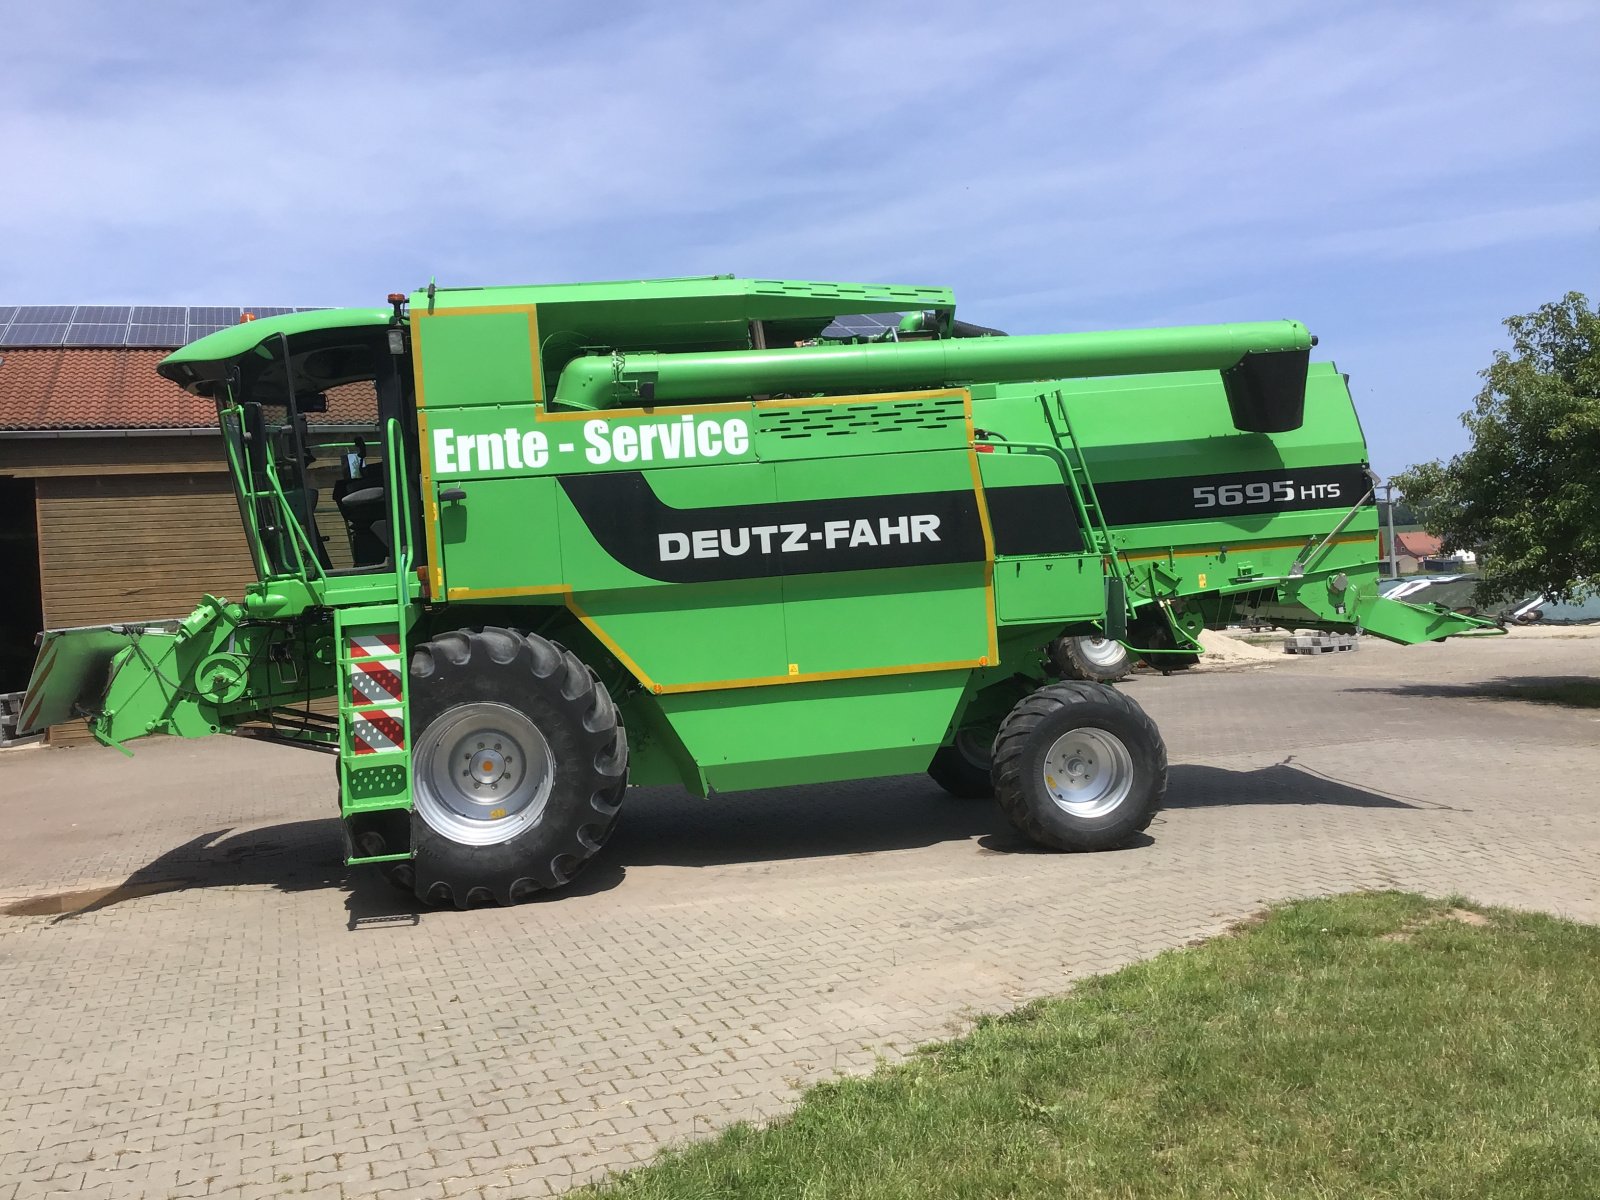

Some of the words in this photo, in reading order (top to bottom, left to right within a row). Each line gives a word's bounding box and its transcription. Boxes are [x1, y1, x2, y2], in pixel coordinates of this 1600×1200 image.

[433, 428, 549, 473] Ernte
[584, 414, 749, 464] Service
[1193, 480, 1295, 508] 5695
[1300, 483, 1341, 500] HTS
[658, 514, 941, 562] DEUTZ-FAHR
